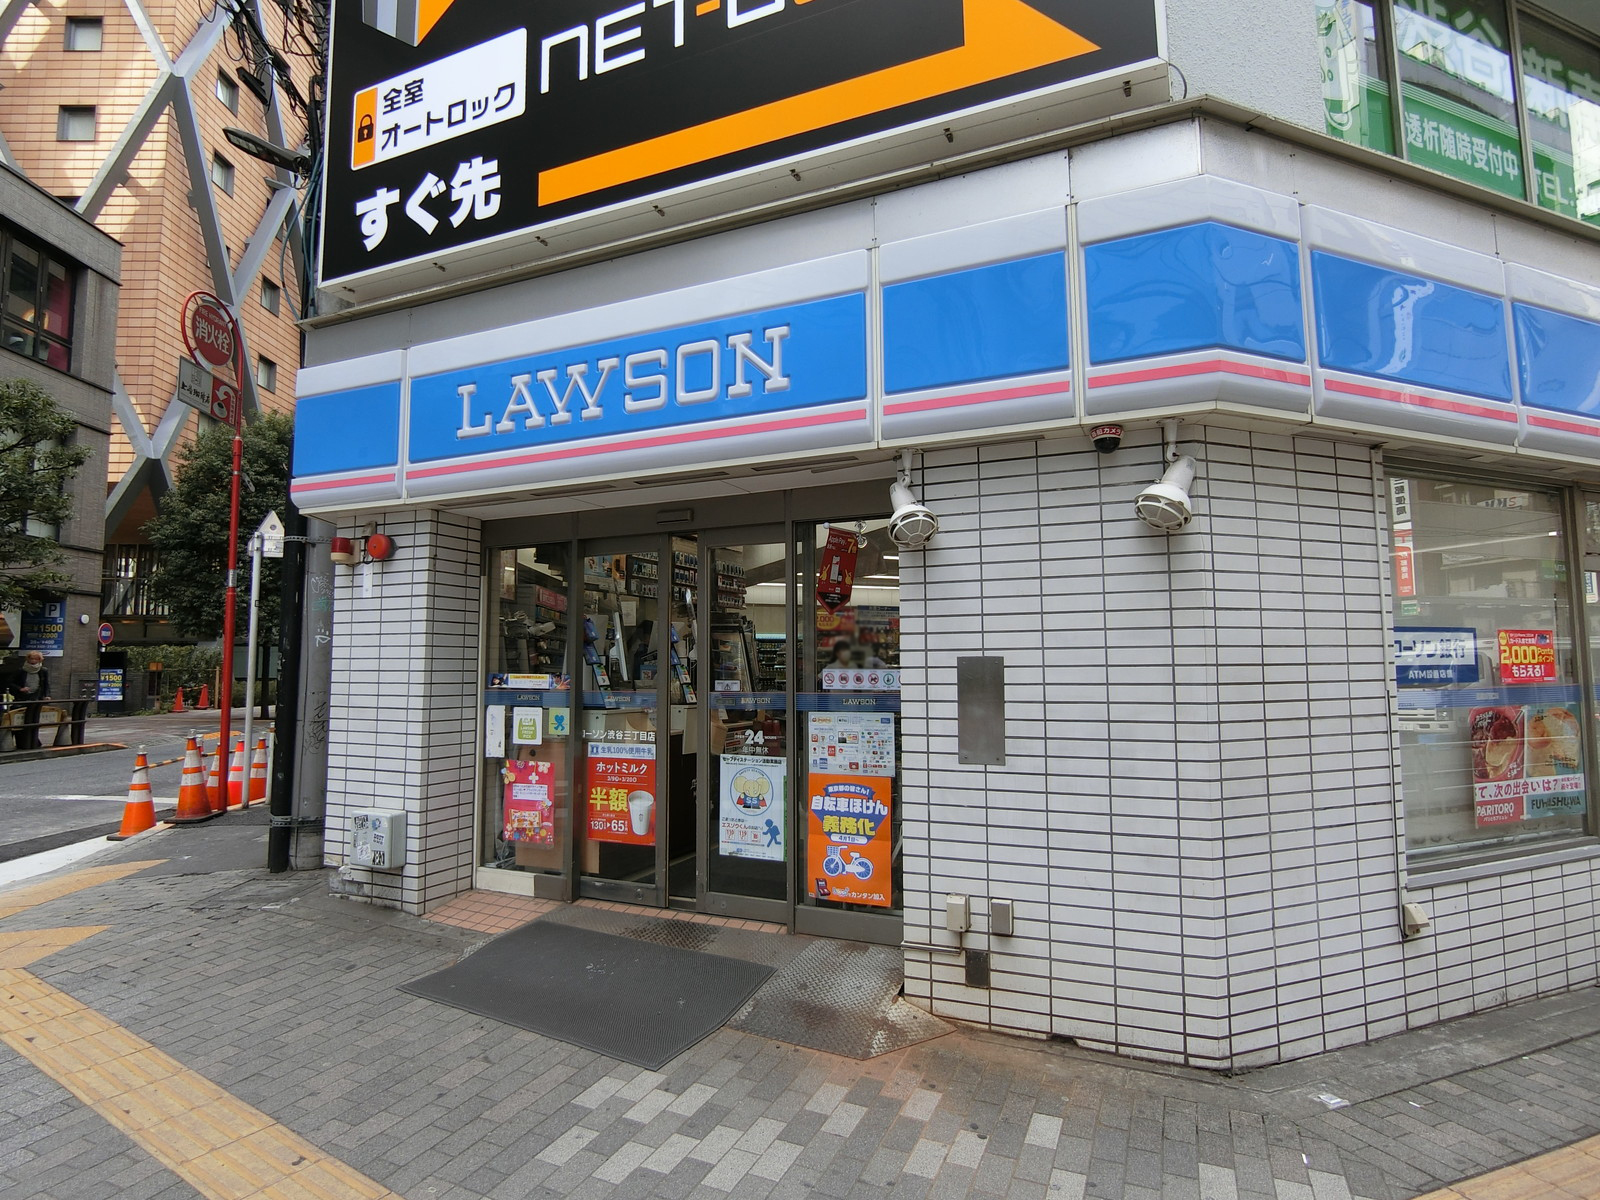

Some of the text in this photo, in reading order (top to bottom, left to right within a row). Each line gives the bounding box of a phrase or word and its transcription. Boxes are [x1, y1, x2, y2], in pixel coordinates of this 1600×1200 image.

[382, 79, 425, 116] 全室
[381, 82, 515, 151] オートロック
[1405, 112, 1519, 181] 透析随時受付中
[355, 156, 501, 251] すぐ先
[195, 315, 231, 355] 消火栓
[456, 325, 790, 440] LAWSON
[48, 604, 57, 616] P
[1500, 646, 1537, 664] 2,000
[1512, 664, 1545, 677] もらえる!
[744, 729, 765, 745] 24
[596, 761, 648, 774] ホットミルク
[589, 786, 629, 812] 半額
[1475, 778, 1559, 799] て、次の出会いは?
[811, 795, 888, 816] 自転車ほけん
[590, 820, 604, 830] 130
[611, 819, 625, 832] 65
[823, 815, 876, 836] 義務化
